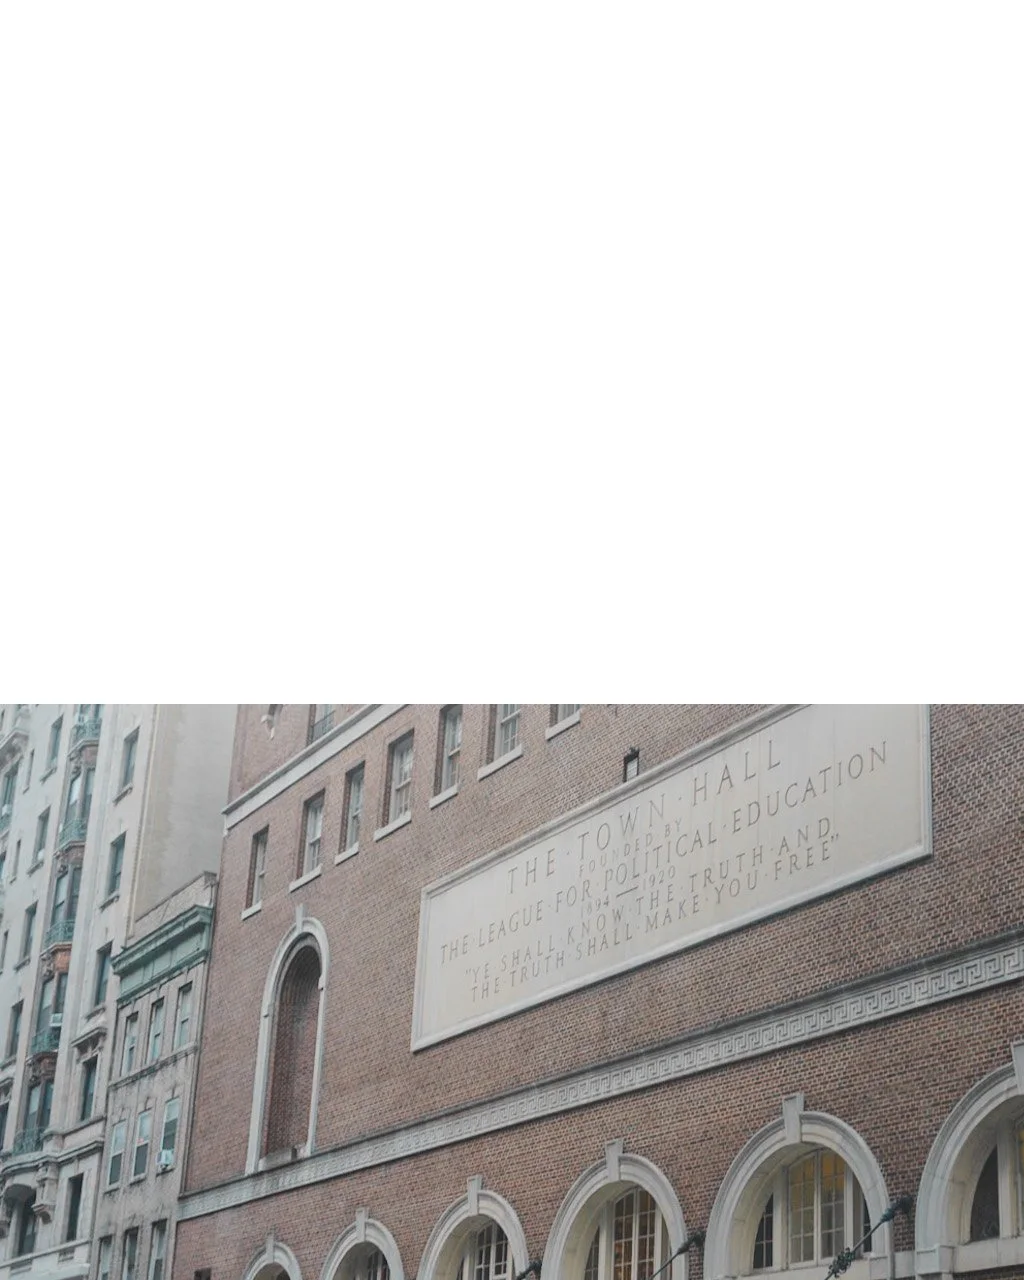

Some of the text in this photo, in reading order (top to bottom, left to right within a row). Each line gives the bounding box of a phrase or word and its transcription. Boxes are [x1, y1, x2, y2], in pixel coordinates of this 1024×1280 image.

[440, 741, 887, 965] THE LEAGUE FOR POLITICAL EDUCATION
[508, 740, 780, 894] THE TOWN HALL
[580, 817, 683, 877] FOUNDED BY
[471, 976, 500, 1002] THE
[510, 950, 565, 987] TRUTH
[576, 923, 633, 961] SHALL
[645, 895, 700, 934] MAKE
[714, 869, 758, 904] YOU
[501, 935, 554, 972] SHALL
[567, 906, 624, 945] KNOW
[636, 884, 673, 915] THE
[689, 845, 764, 892] TRUTH
[778, 817, 830, 856] AND
